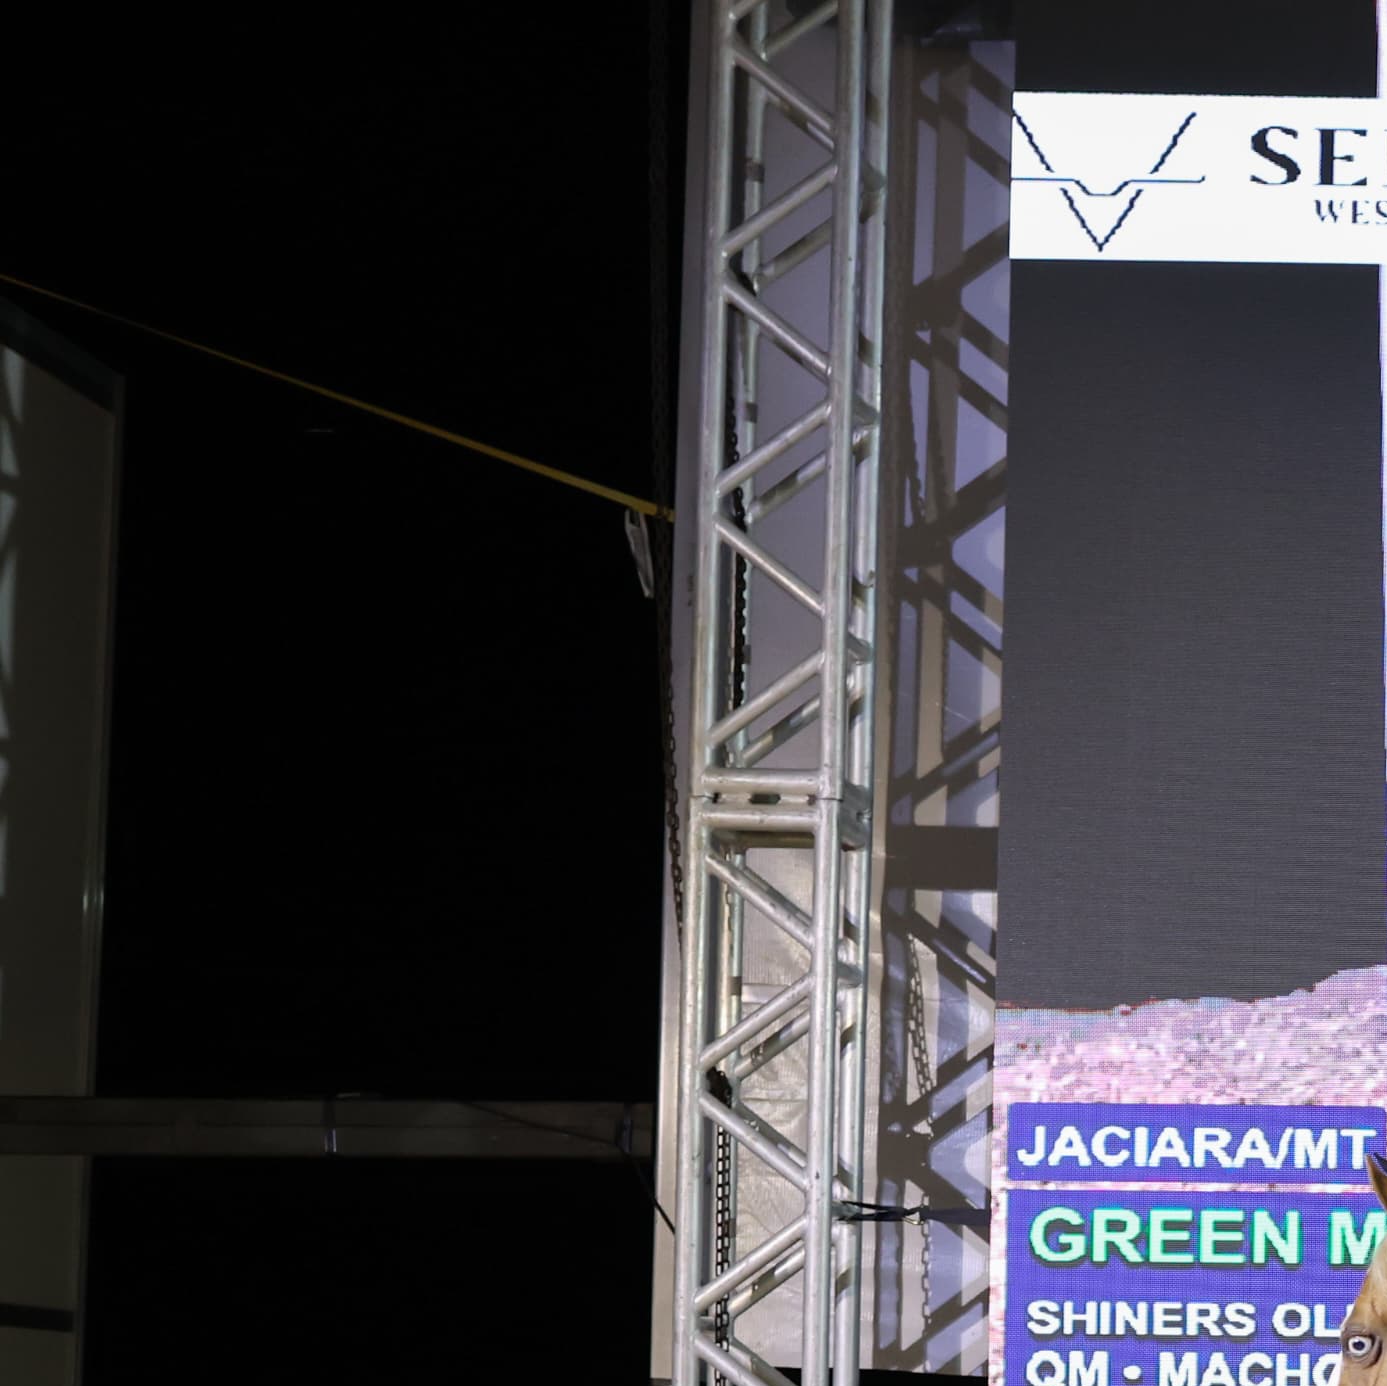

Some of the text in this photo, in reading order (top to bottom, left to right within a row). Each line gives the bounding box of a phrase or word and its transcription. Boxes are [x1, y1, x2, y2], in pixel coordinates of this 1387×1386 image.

[1017, 1126, 1377, 1170] JACIARA/MT
[1029, 1207, 1301, 1266] GREEN
[1027, 1300, 1257, 1337] SHINERS
